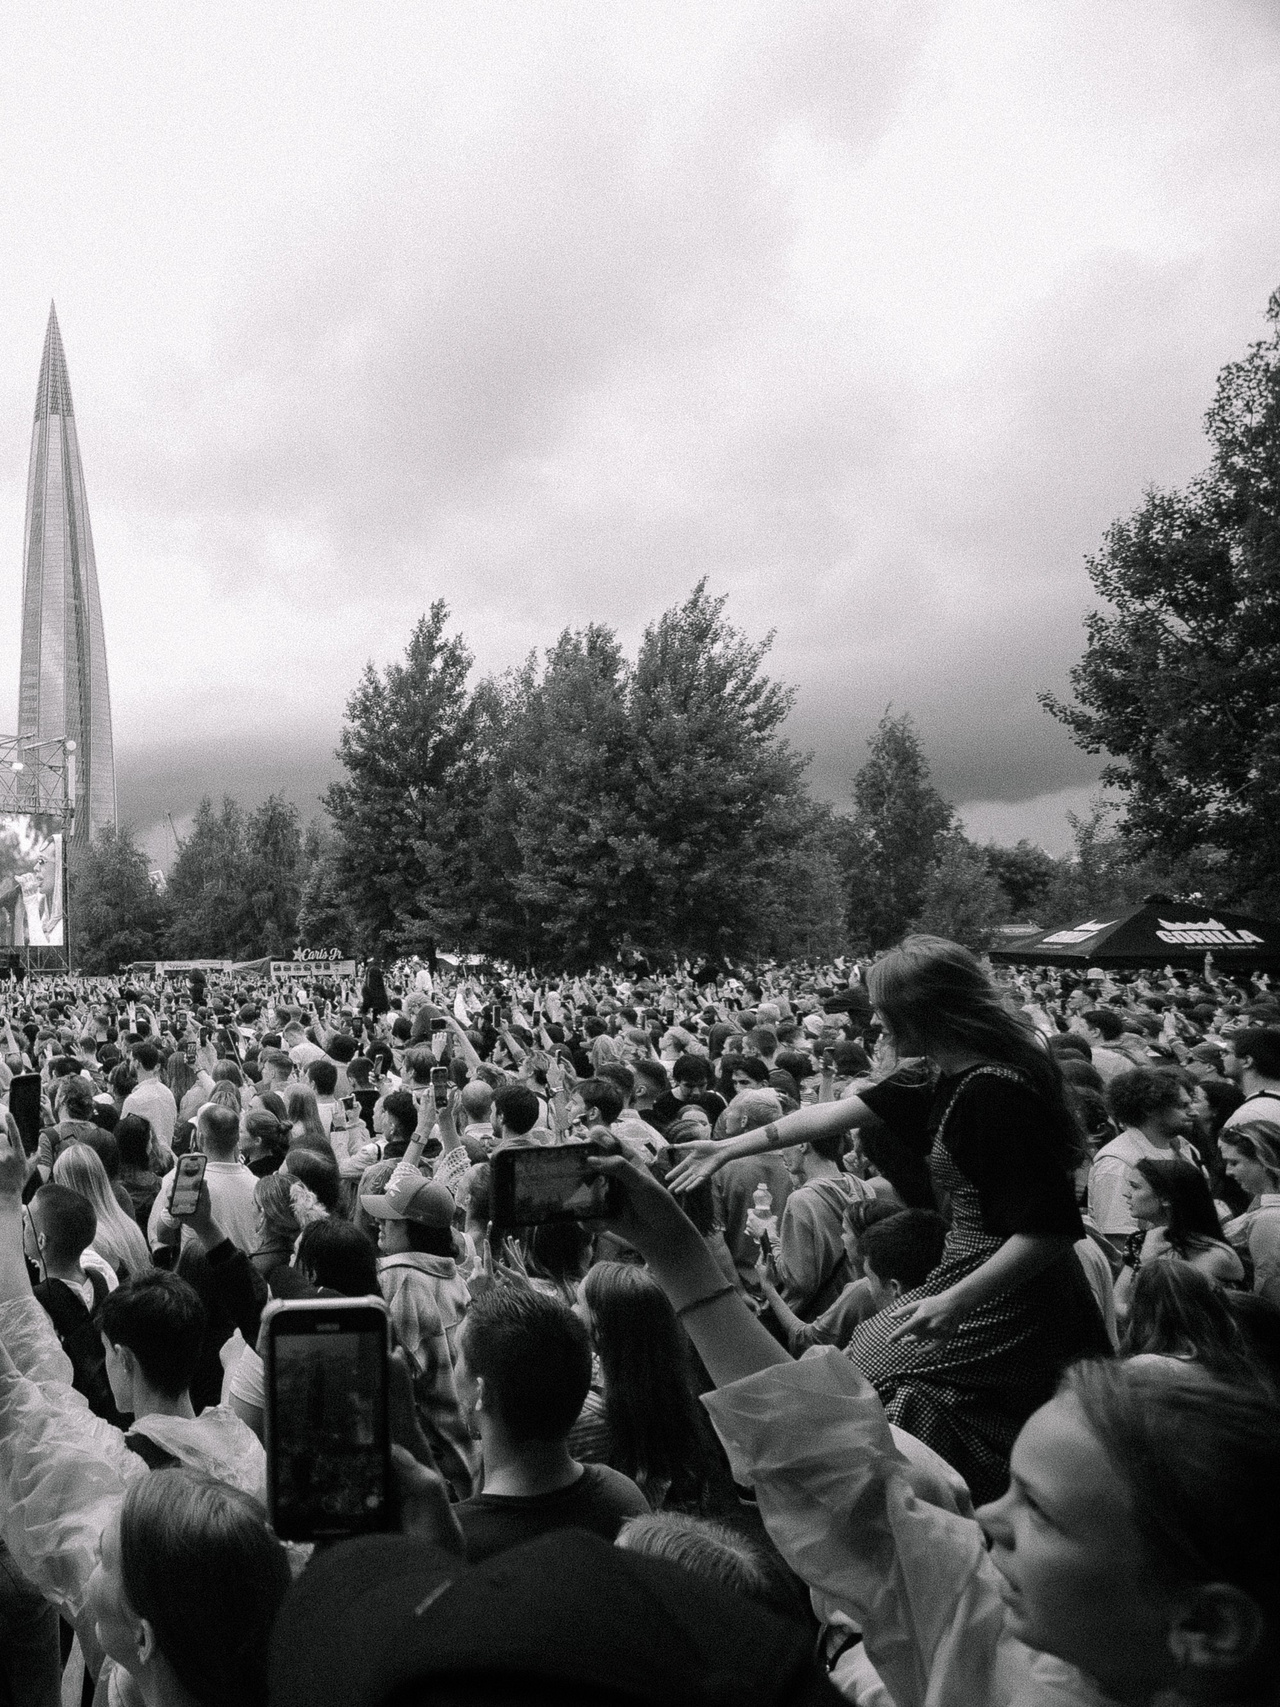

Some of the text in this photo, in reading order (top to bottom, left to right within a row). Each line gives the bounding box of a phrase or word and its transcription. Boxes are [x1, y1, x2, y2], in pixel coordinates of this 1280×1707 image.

[1155, 929, 1265, 944] GORILLA
[301, 948, 344, 961] Carl's Jr.
